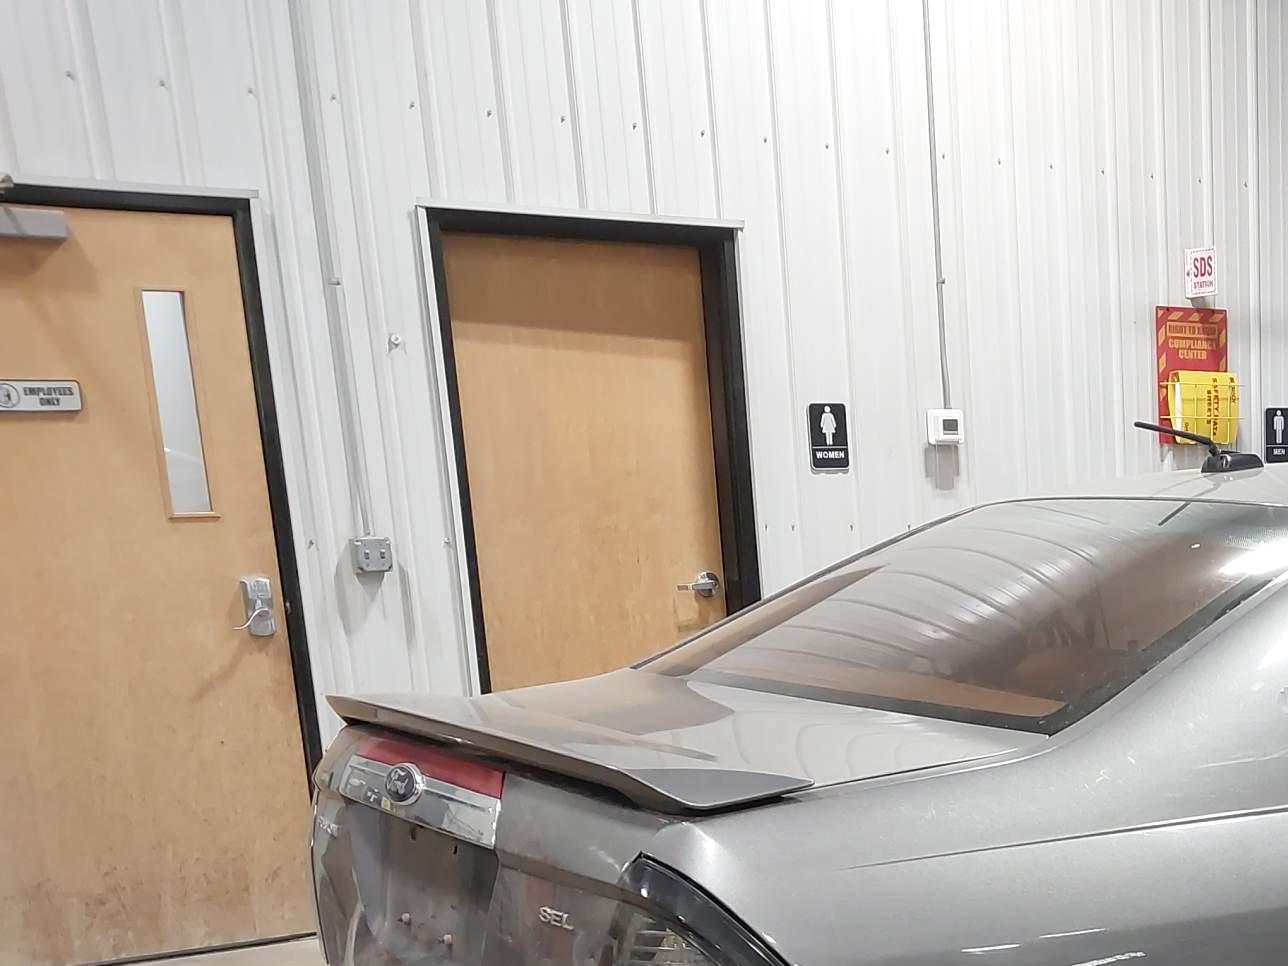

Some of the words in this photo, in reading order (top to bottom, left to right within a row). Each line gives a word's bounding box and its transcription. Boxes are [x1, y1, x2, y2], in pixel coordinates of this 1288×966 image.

[1193, 255, 1213, 278] SDS
[1193, 280, 1214, 289] STATION
[1178, 350, 1207, 360] CENTER
[23, 386, 74, 396] EMPLOYEES
[39, 397, 61, 406] ONLY
[815, 450, 845, 459] WOMEN
[1273, 448, 1286, 456] MEN
[537, 905, 576, 931] SEL
